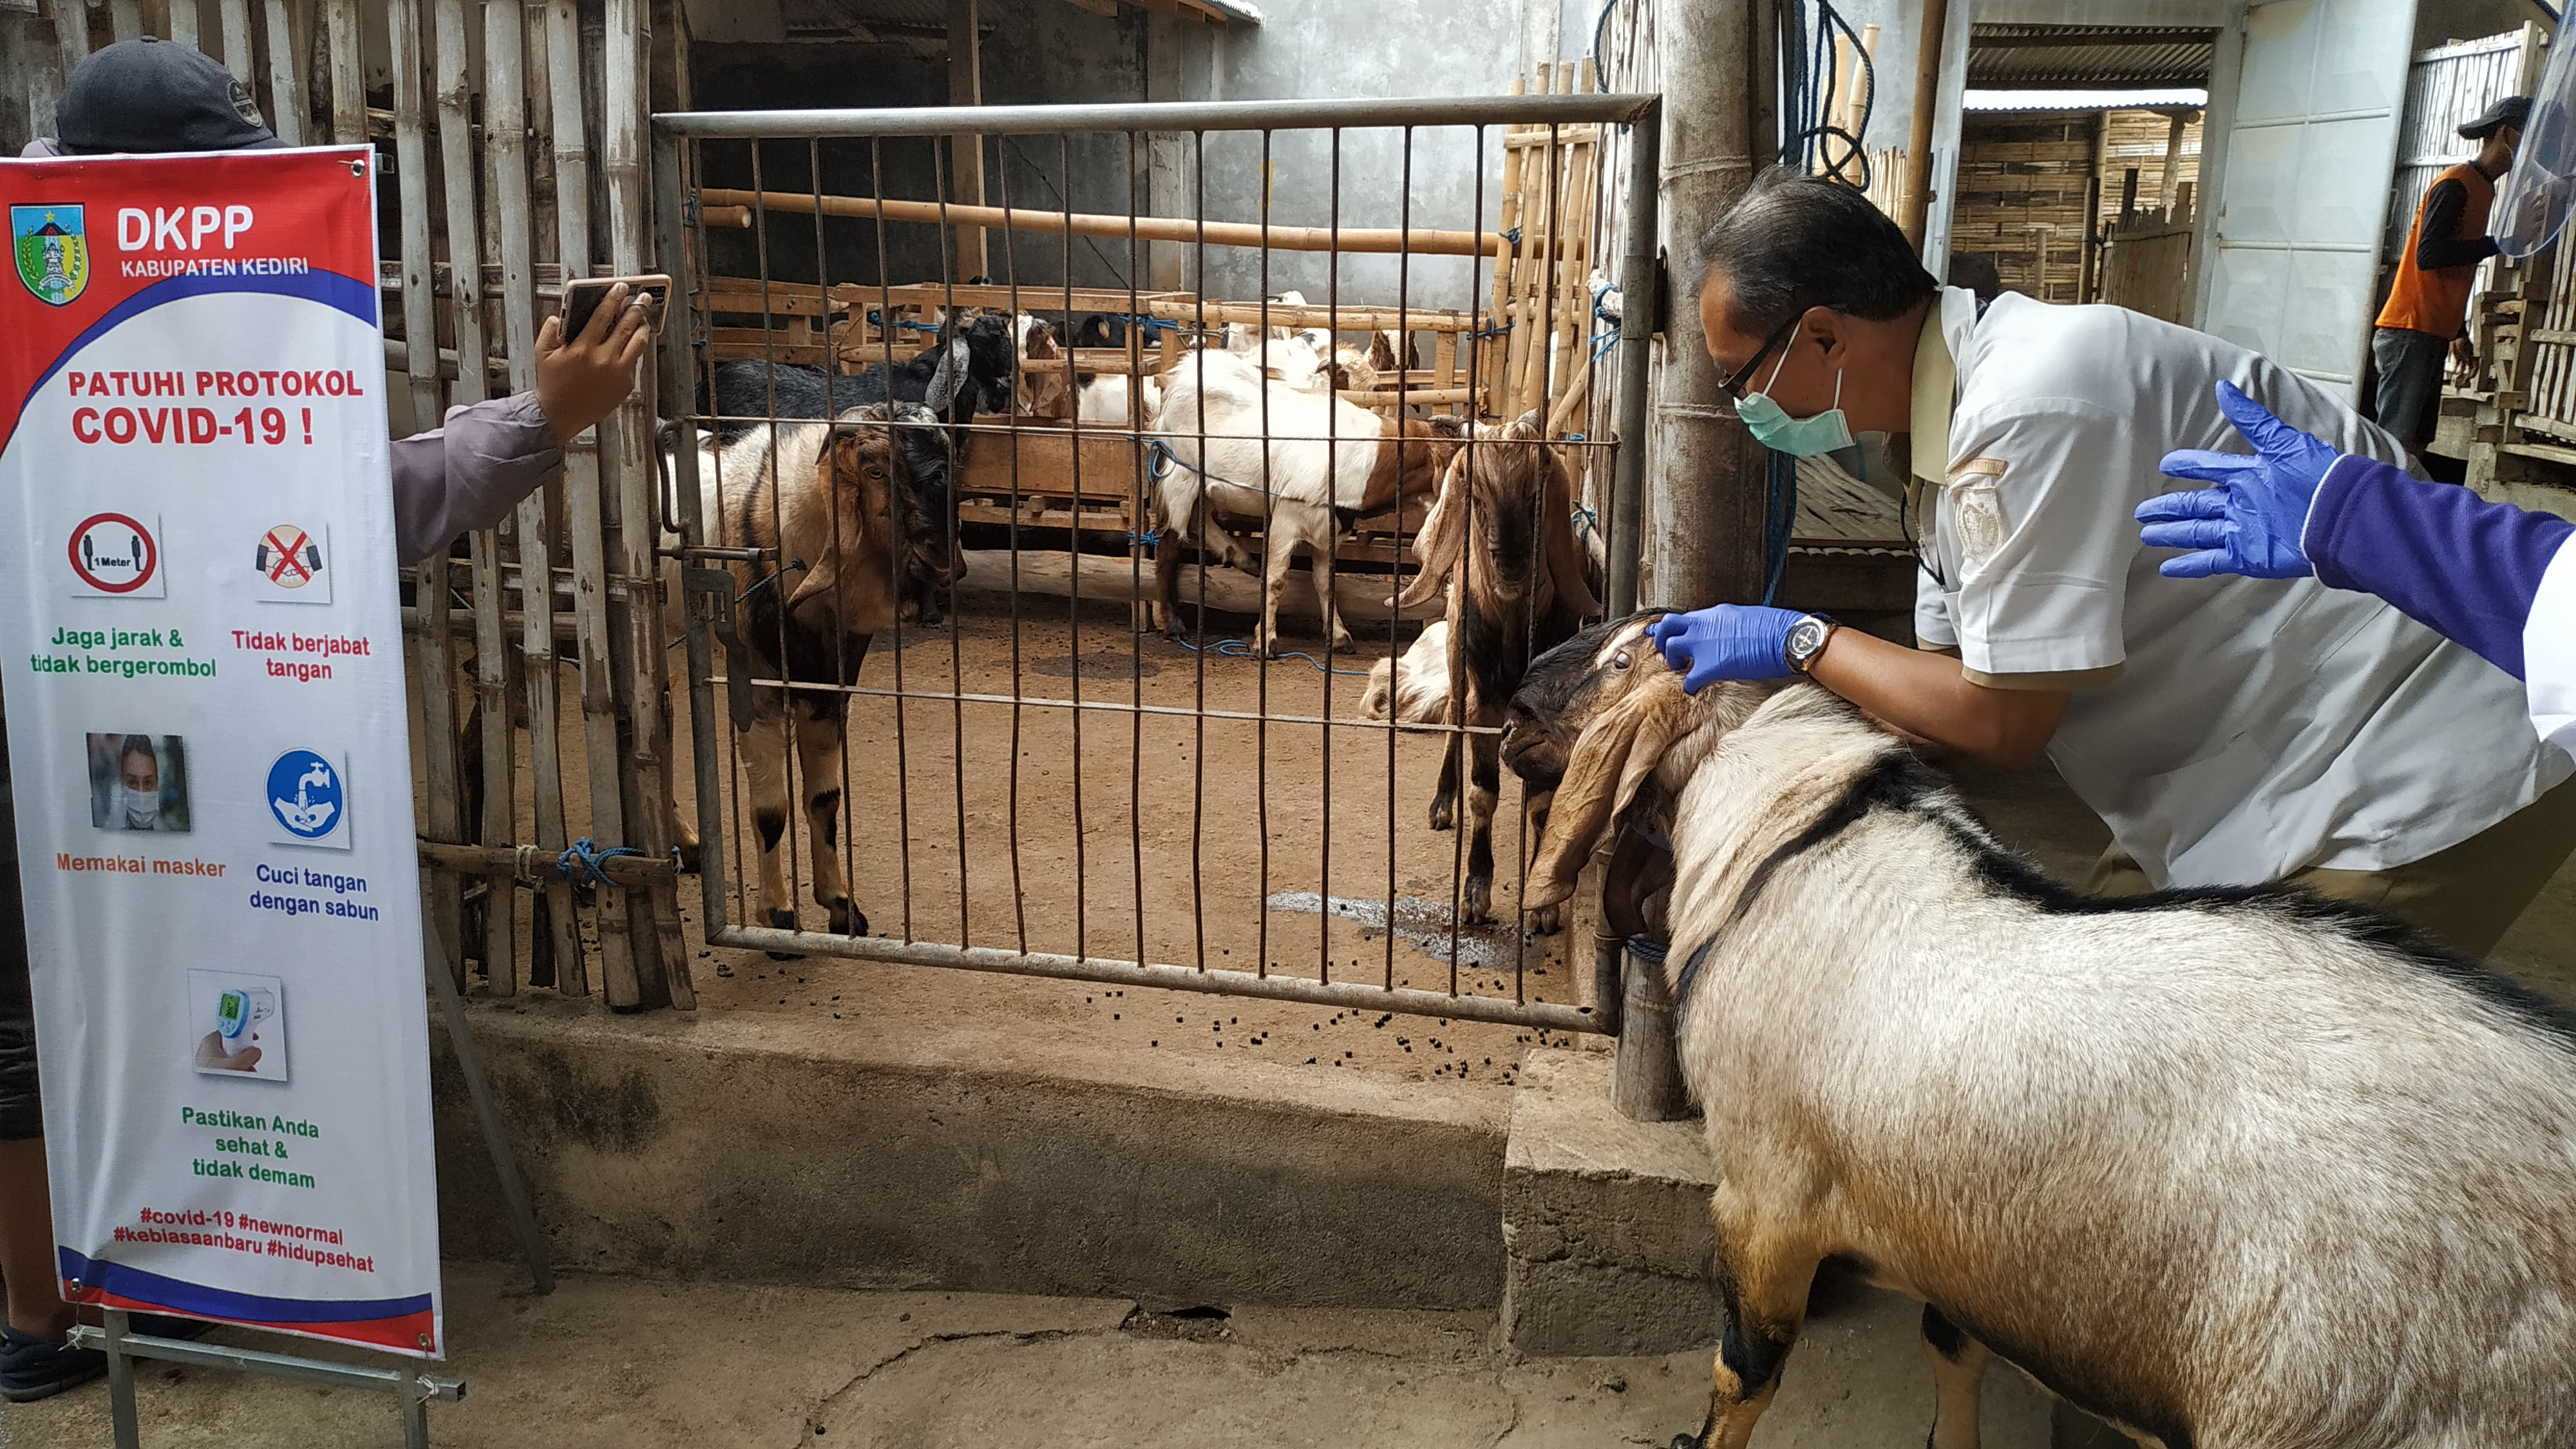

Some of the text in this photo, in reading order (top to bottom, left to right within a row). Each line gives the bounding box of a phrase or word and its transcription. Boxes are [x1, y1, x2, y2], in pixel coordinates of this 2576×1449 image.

[118, 206, 252, 251] DKPP
[122, 258, 308, 276] KABUPATEN KEDIRI
[69, 370, 363, 396] PATUHI PROTOKOL
[73, 408, 312, 444] COVID-19 !
[94, 556, 131, 566] 1 Meter
[52, 627, 184, 650] Jaga jarak &
[231, 630, 370, 658] Tidak berjabat
[31, 654, 216, 678] tidak bergerombol
[267, 658, 331, 682] tangan
[57, 853, 226, 877] Memakai masker
[257, 864, 366, 893] Cuci tangan
[251, 891, 378, 921] dengan sabun
[182, 1107, 319, 1138] Pastikan Anda
[216, 1137, 288, 1159] sehat &
[193, 1159, 315, 1188] tidak demam
[140, 1208, 343, 1245] #covid-19 #newnormal
[114, 1227, 374, 1273] #kebiasaanbaru #hidupsehat
